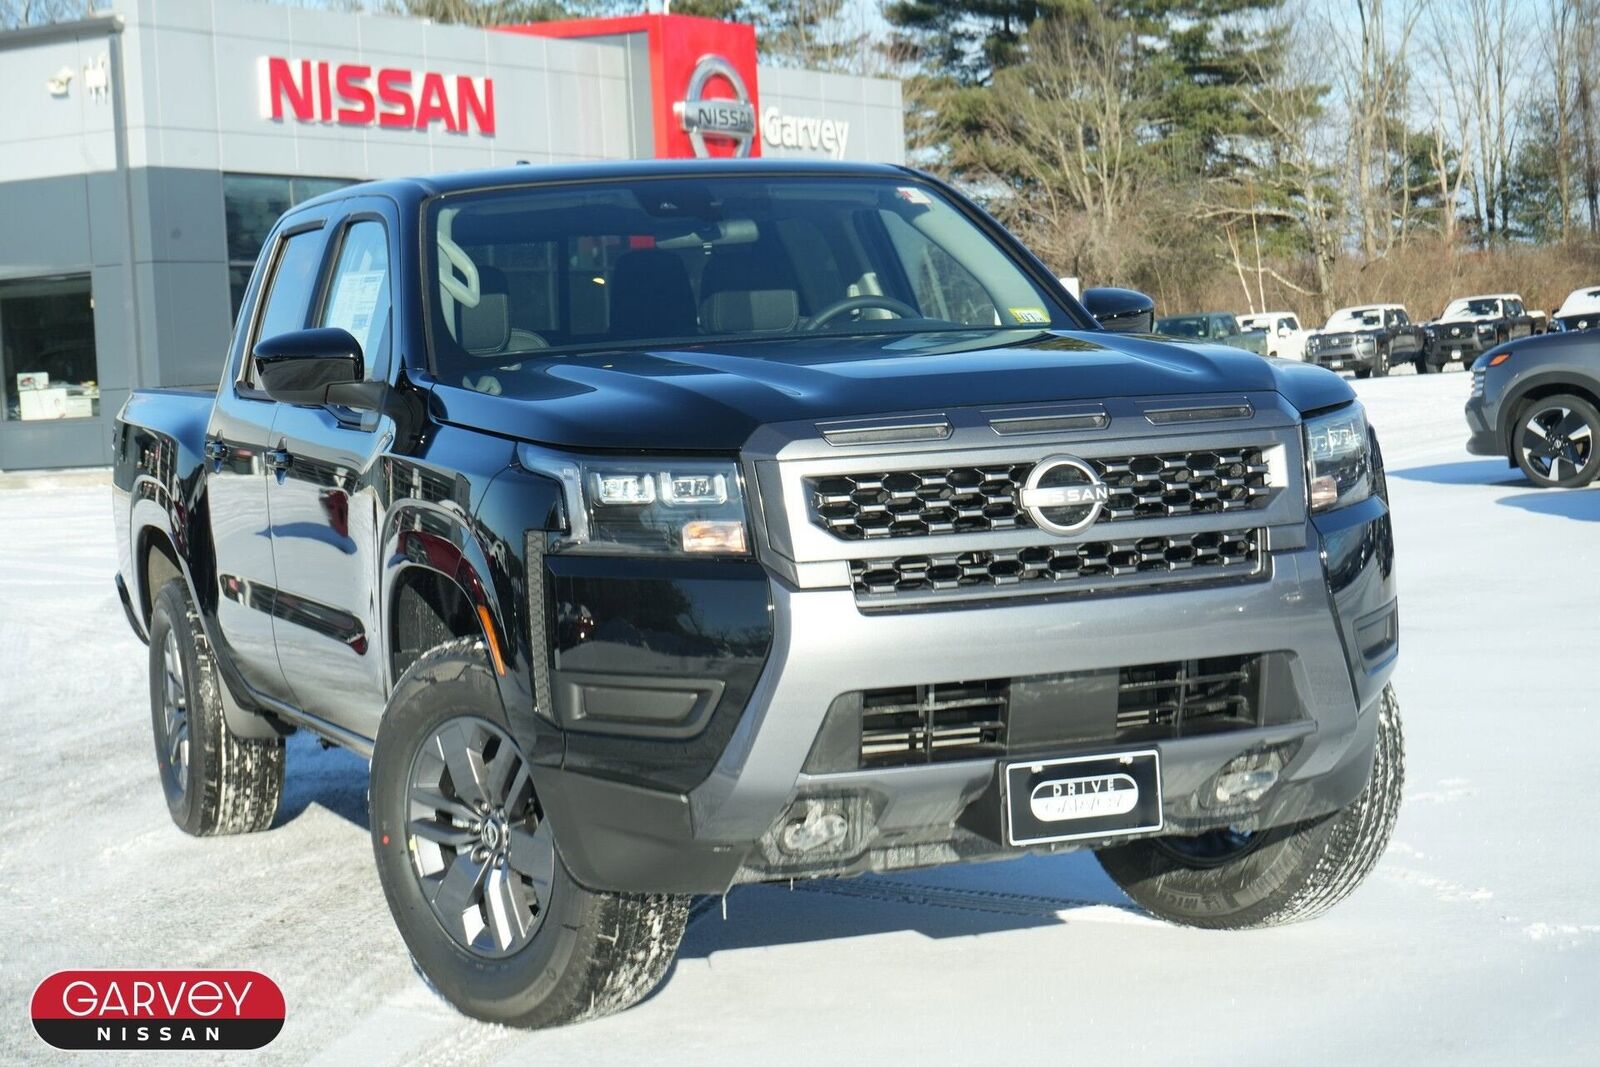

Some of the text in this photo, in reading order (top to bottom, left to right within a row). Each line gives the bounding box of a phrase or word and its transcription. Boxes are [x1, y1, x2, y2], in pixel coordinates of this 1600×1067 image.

[264, 57, 496, 137] NISSAN
[763, 106, 850, 161] Garvey
[1052, 778, 1115, 798] DRIVE
